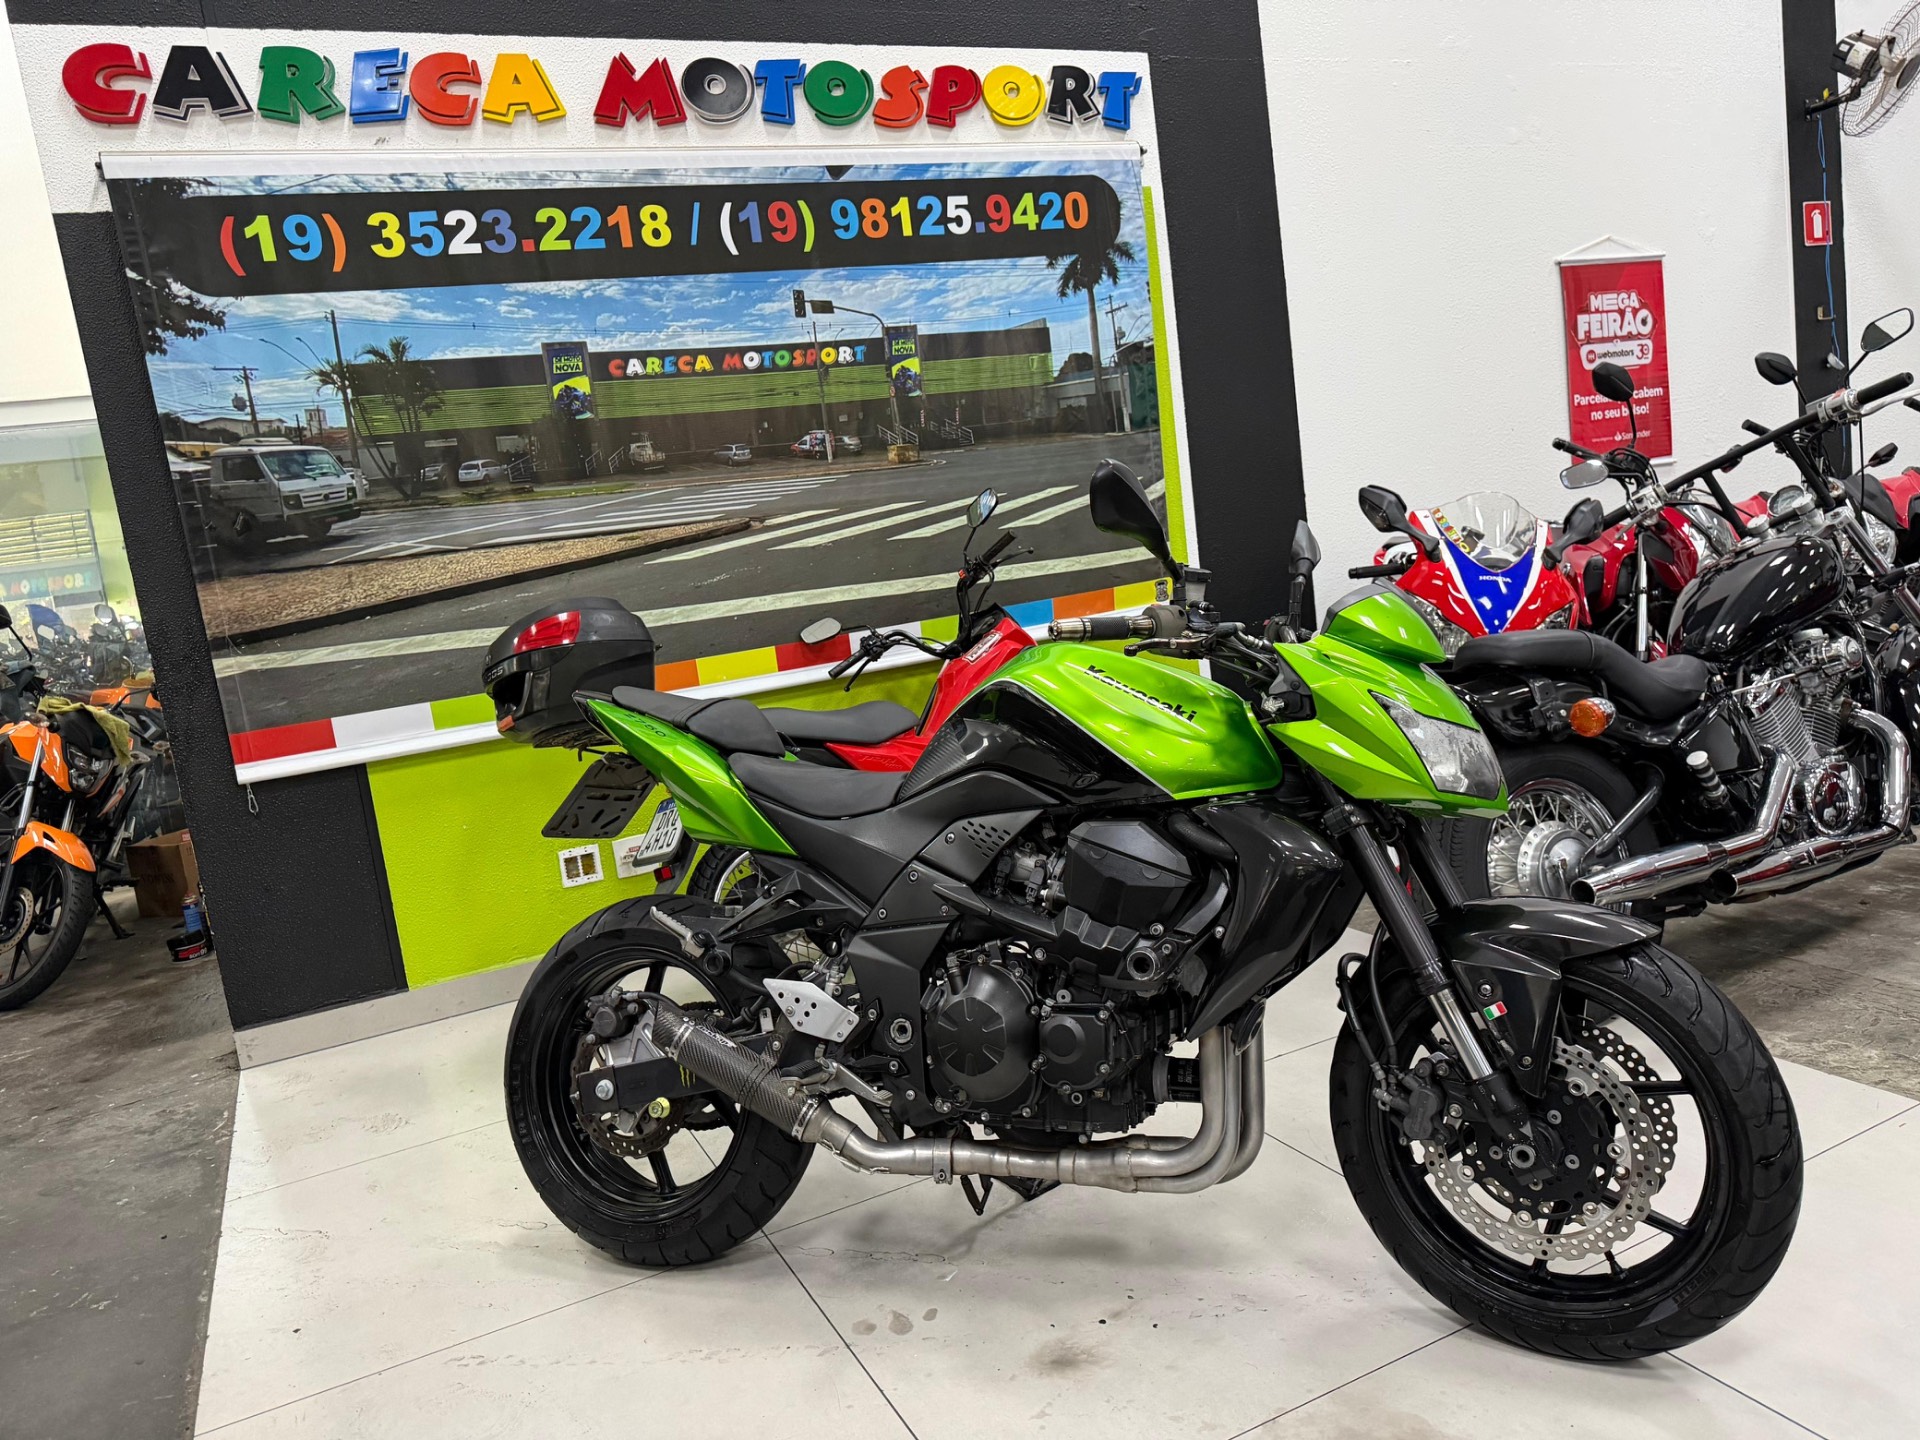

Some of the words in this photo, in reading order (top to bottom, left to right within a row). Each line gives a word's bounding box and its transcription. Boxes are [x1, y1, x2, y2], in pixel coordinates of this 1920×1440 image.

[61, 42, 567, 126] CARECA
[592, 51, 1142, 131] MOTOSPORT
[219, 212, 349, 277] (19)
[366, 204, 673, 258] 3523.2218
[719, 199, 815, 256] (19)
[830, 191, 1090, 241] 98125.9420
[1590, 292, 1640, 312] MEGA
[1577, 307, 1653, 340] FEIRÃO
[893, 345, 914, 355] NOVA
[1597, 348, 1635, 359] webmotors
[555, 363, 581, 373] NOVA
[608, 354, 714, 377] CARECA
[722, 345, 867, 371] MOTOSPORT
[1573, 393, 1614, 407] Parcela
[1632, 386, 1664, 399] cabem
[1591, 410, 1604, 421] no
[1604, 407, 1621, 419] seu
[1622, 401, 1650, 418] blso!
[1621, 429, 1651, 441] Sannder
[1479, 575, 1513, 583] HONDA
[1084, 664, 1198, 723] Kawasaki
